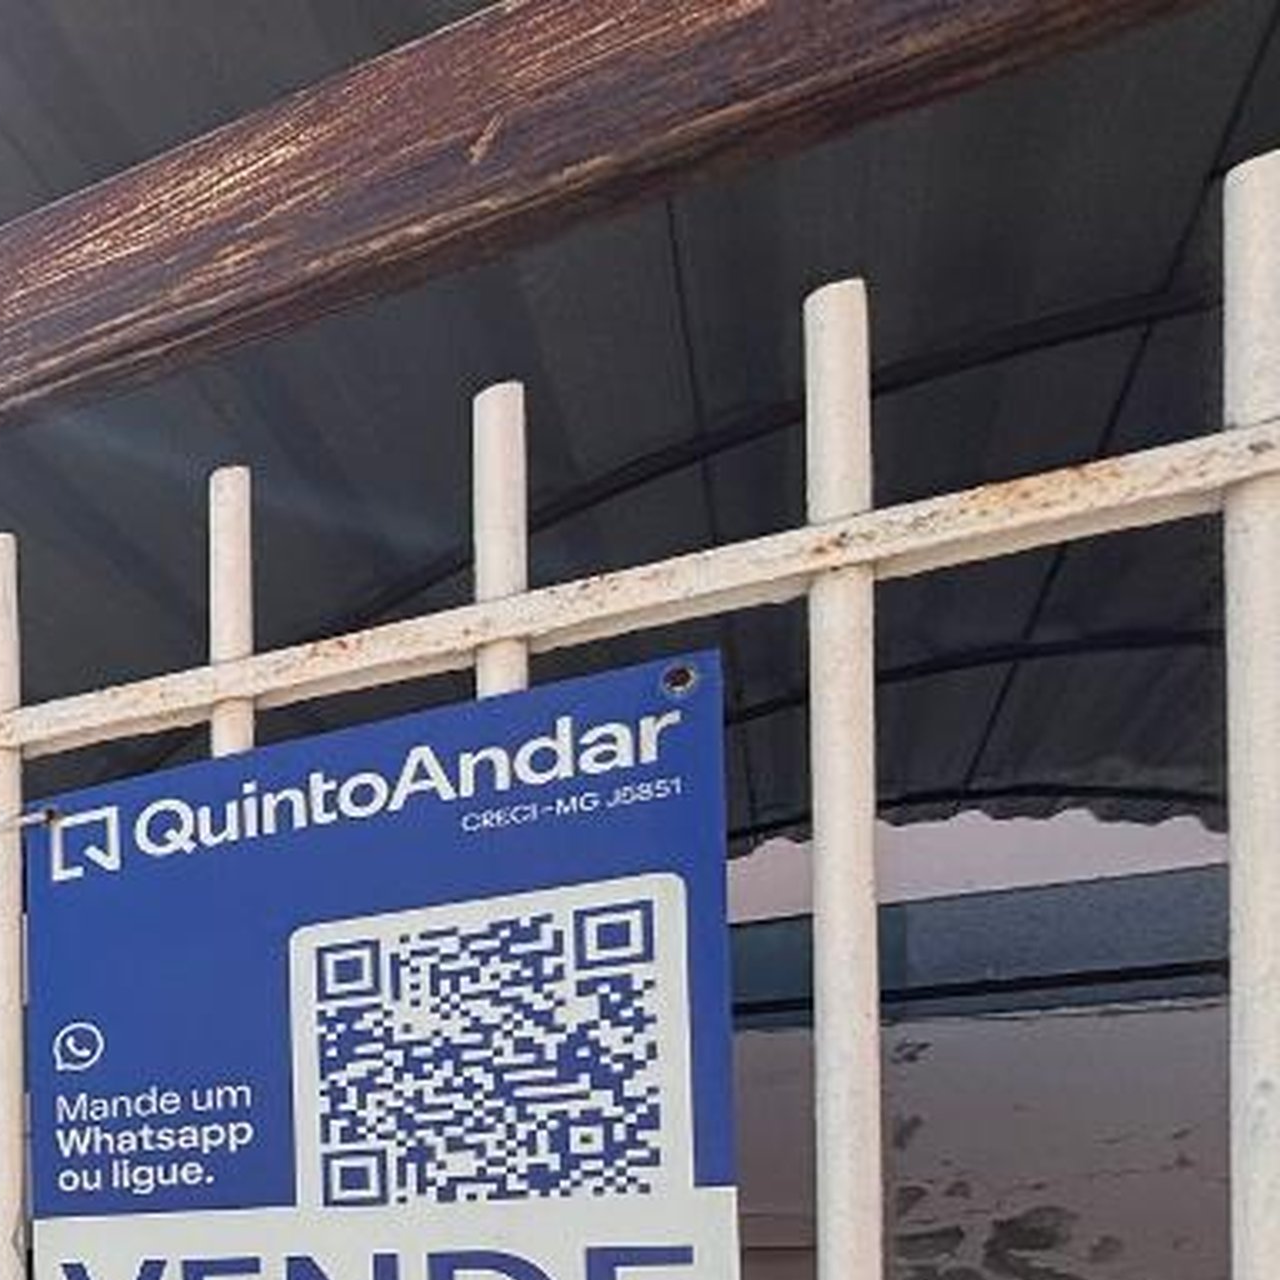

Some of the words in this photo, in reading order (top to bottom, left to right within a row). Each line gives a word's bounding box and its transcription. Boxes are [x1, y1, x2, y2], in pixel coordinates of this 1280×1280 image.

[135, 710, 681, 855] QuintoAndar
[56, 1086, 181, 1123] Mande
[192, 1085, 252, 1111] um
[55, 1121, 254, 1157] Whatsapp
[58, 1169, 102, 1191] ou
[112, 1159, 215, 1194] ligue.
